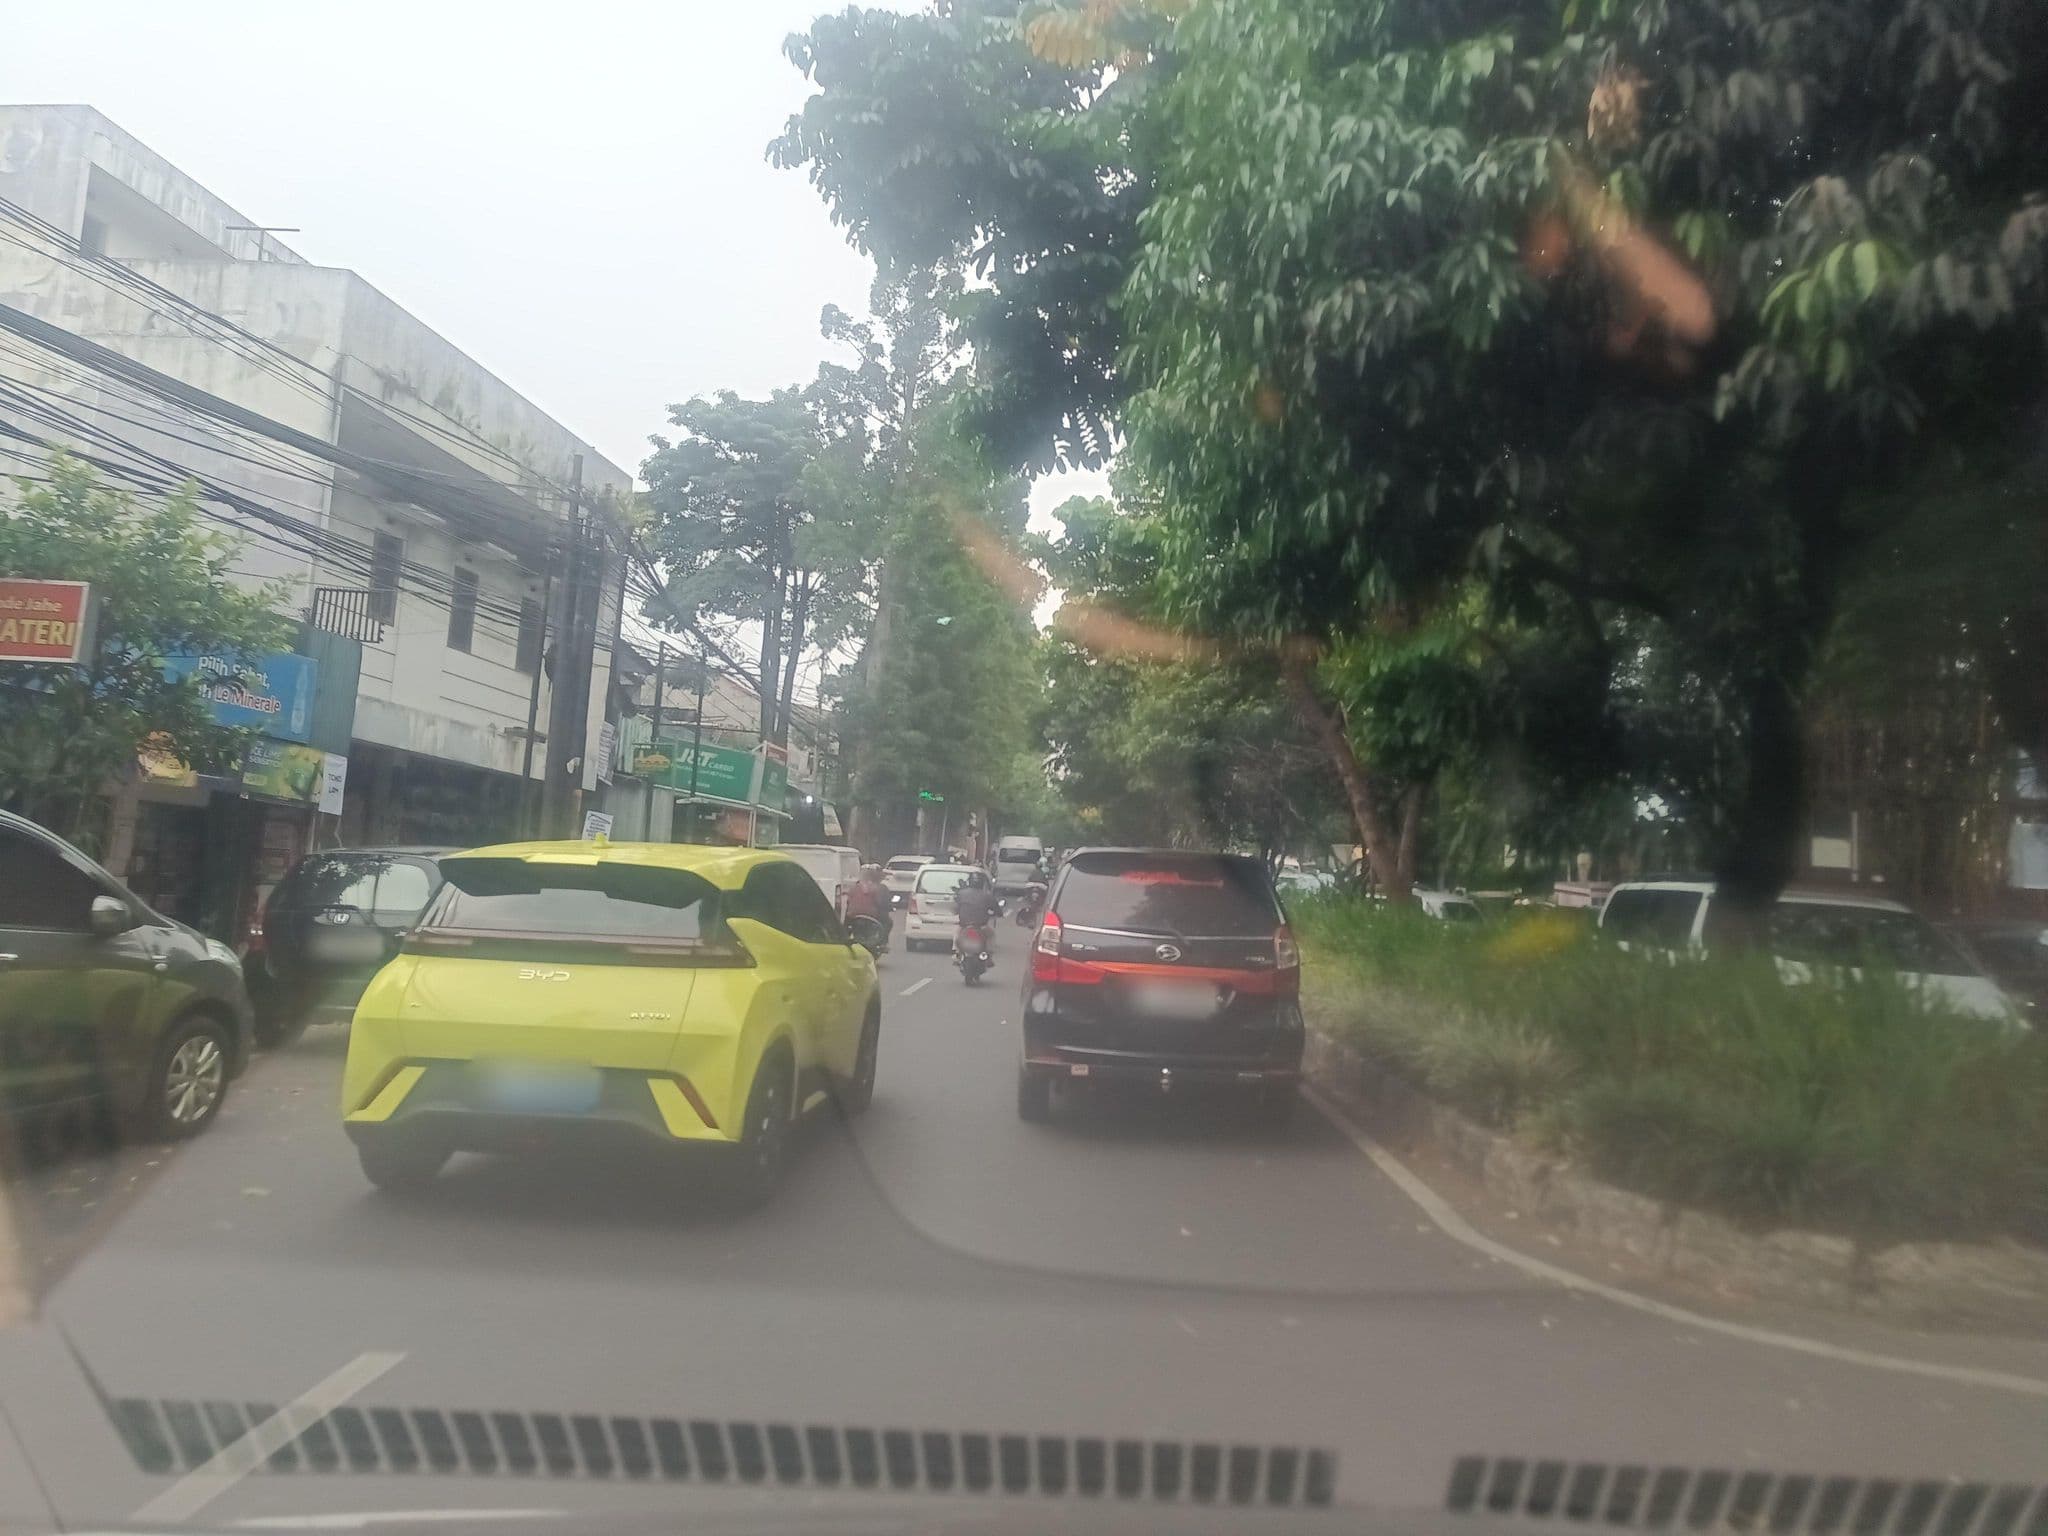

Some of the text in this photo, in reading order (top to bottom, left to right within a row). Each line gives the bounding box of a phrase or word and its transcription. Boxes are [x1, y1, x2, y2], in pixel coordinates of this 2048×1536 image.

[0, 617, 76, 646] ATERI
[230, 686, 281, 713] Minerale
[518, 968, 570, 982] BYD
